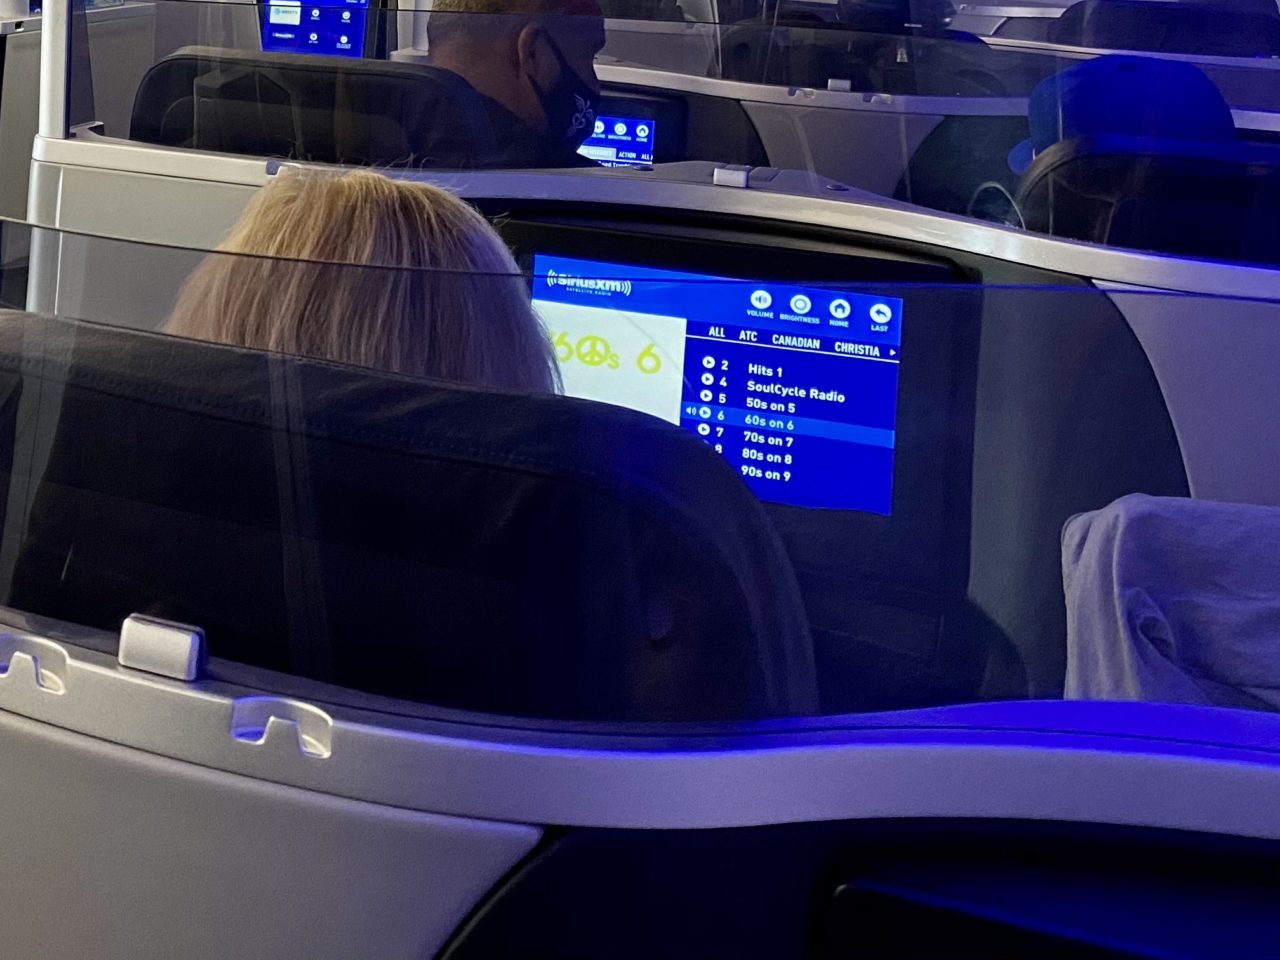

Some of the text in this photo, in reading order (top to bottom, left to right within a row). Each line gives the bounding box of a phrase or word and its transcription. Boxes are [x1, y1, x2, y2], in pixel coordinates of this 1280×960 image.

[746, 309, 774, 319] VOLUME
[779, 313, 820, 325] BRIGHTNESS
[829, 319, 849, 328] HOME
[871, 324, 889, 332] LAST
[708, 326, 726, 338] ALL
[738, 330, 758, 342] ATC
[772, 334, 820, 349] CANADIAN
[834, 342, 880, 357] CHRISTIA
[636, 342, 662, 374] 6
[721, 360, 729, 371] 2
[748, 363, 783, 378] Hits 1
[719, 377, 727, 387] 4
[747, 380, 845, 403] SoulCycle Radio
[718, 393, 727, 404] 5
[746, 397, 796, 414] 50s on 5
[717, 410, 725, 421] 6
[744, 414, 794, 431] 60s on 6
[716, 427, 724, 438] 7
[743, 431, 794, 448] 70s on 7
[742, 448, 793, 465] 80s on 8
[741, 465, 792, 482] 90s on 9
